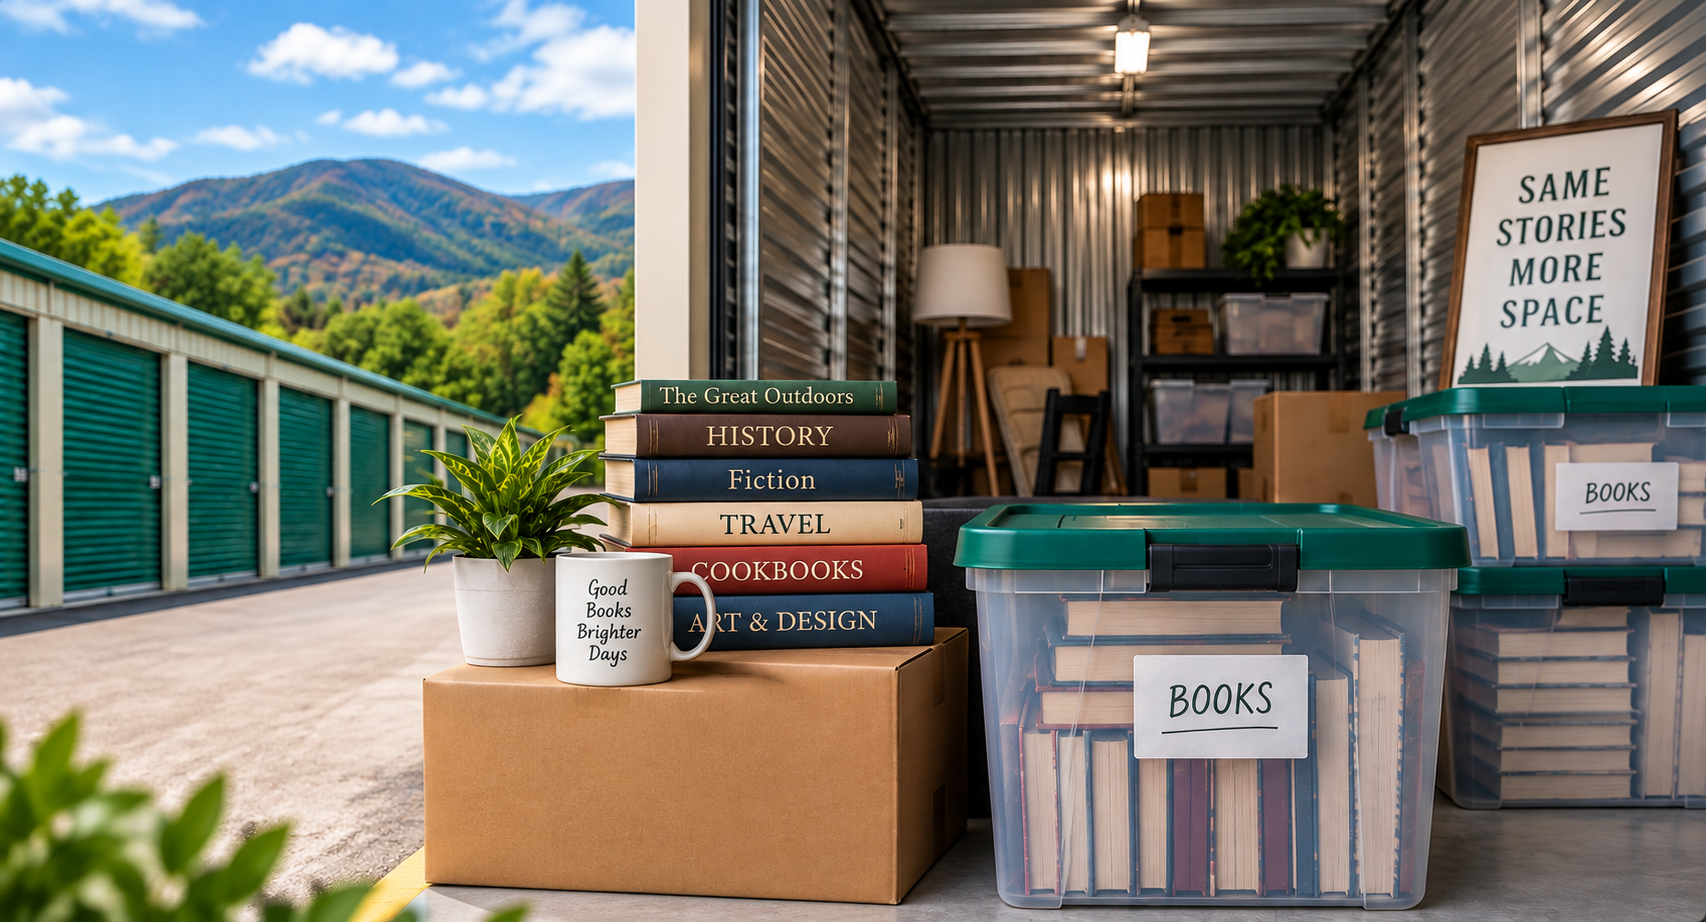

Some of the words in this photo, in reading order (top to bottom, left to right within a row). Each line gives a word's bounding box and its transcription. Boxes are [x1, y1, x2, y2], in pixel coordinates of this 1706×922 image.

[1518, 166, 1611, 204] SAME
[1496, 208, 1626, 246] STORIES
[1509, 252, 1604, 287] MORE
[1500, 294, 1604, 329] SPACE
[659, 386, 698, 405] The
[703, 386, 758, 405] Great
[763, 386, 854, 405] Outdoors
[706, 425, 834, 447] HISTORY
[728, 469, 816, 490] Fiction
[1585, 481, 1651, 504] BOOKS
[720, 513, 831, 535] TRAVEL
[691, 559, 864, 582] COOKBOOKS
[588, 578, 628, 597] Good
[586, 602, 632, 619] Books
[749, 612, 768, 632] &
[776, 610, 878, 632] DESIGN
[577, 623, 642, 645] Brighter
[588, 645, 628, 667] Days
[1169, 681, 1273, 718] BOOKS
